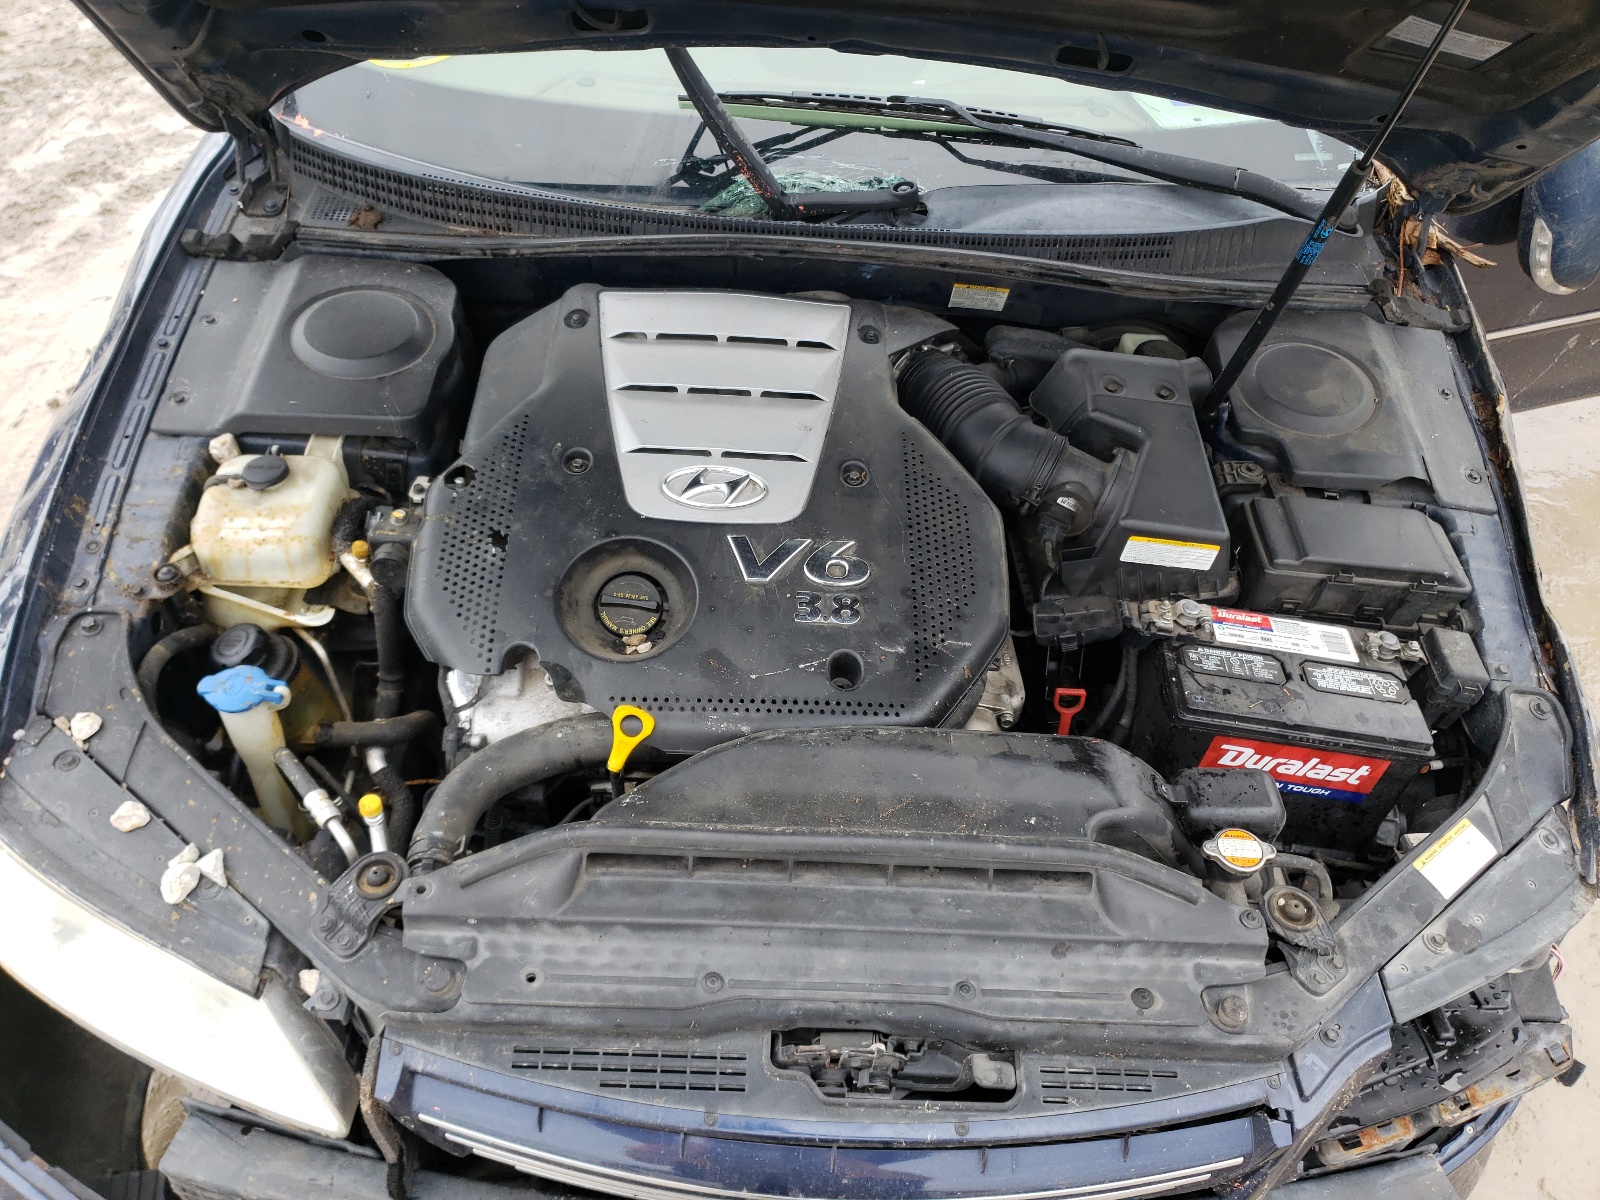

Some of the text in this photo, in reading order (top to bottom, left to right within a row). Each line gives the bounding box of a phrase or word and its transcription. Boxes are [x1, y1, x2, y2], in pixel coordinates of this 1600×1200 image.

[727, 534, 871, 587] V6
[794, 590, 861, 625] 3.8
[1216, 609, 1262, 624] Duralast
[600, 611, 618, 631] MANUAL
[619, 625, 646, 635] OWNER'S
[1217, 744, 1372, 786] Duralast
[1287, 784, 1332, 796] TOUGH
